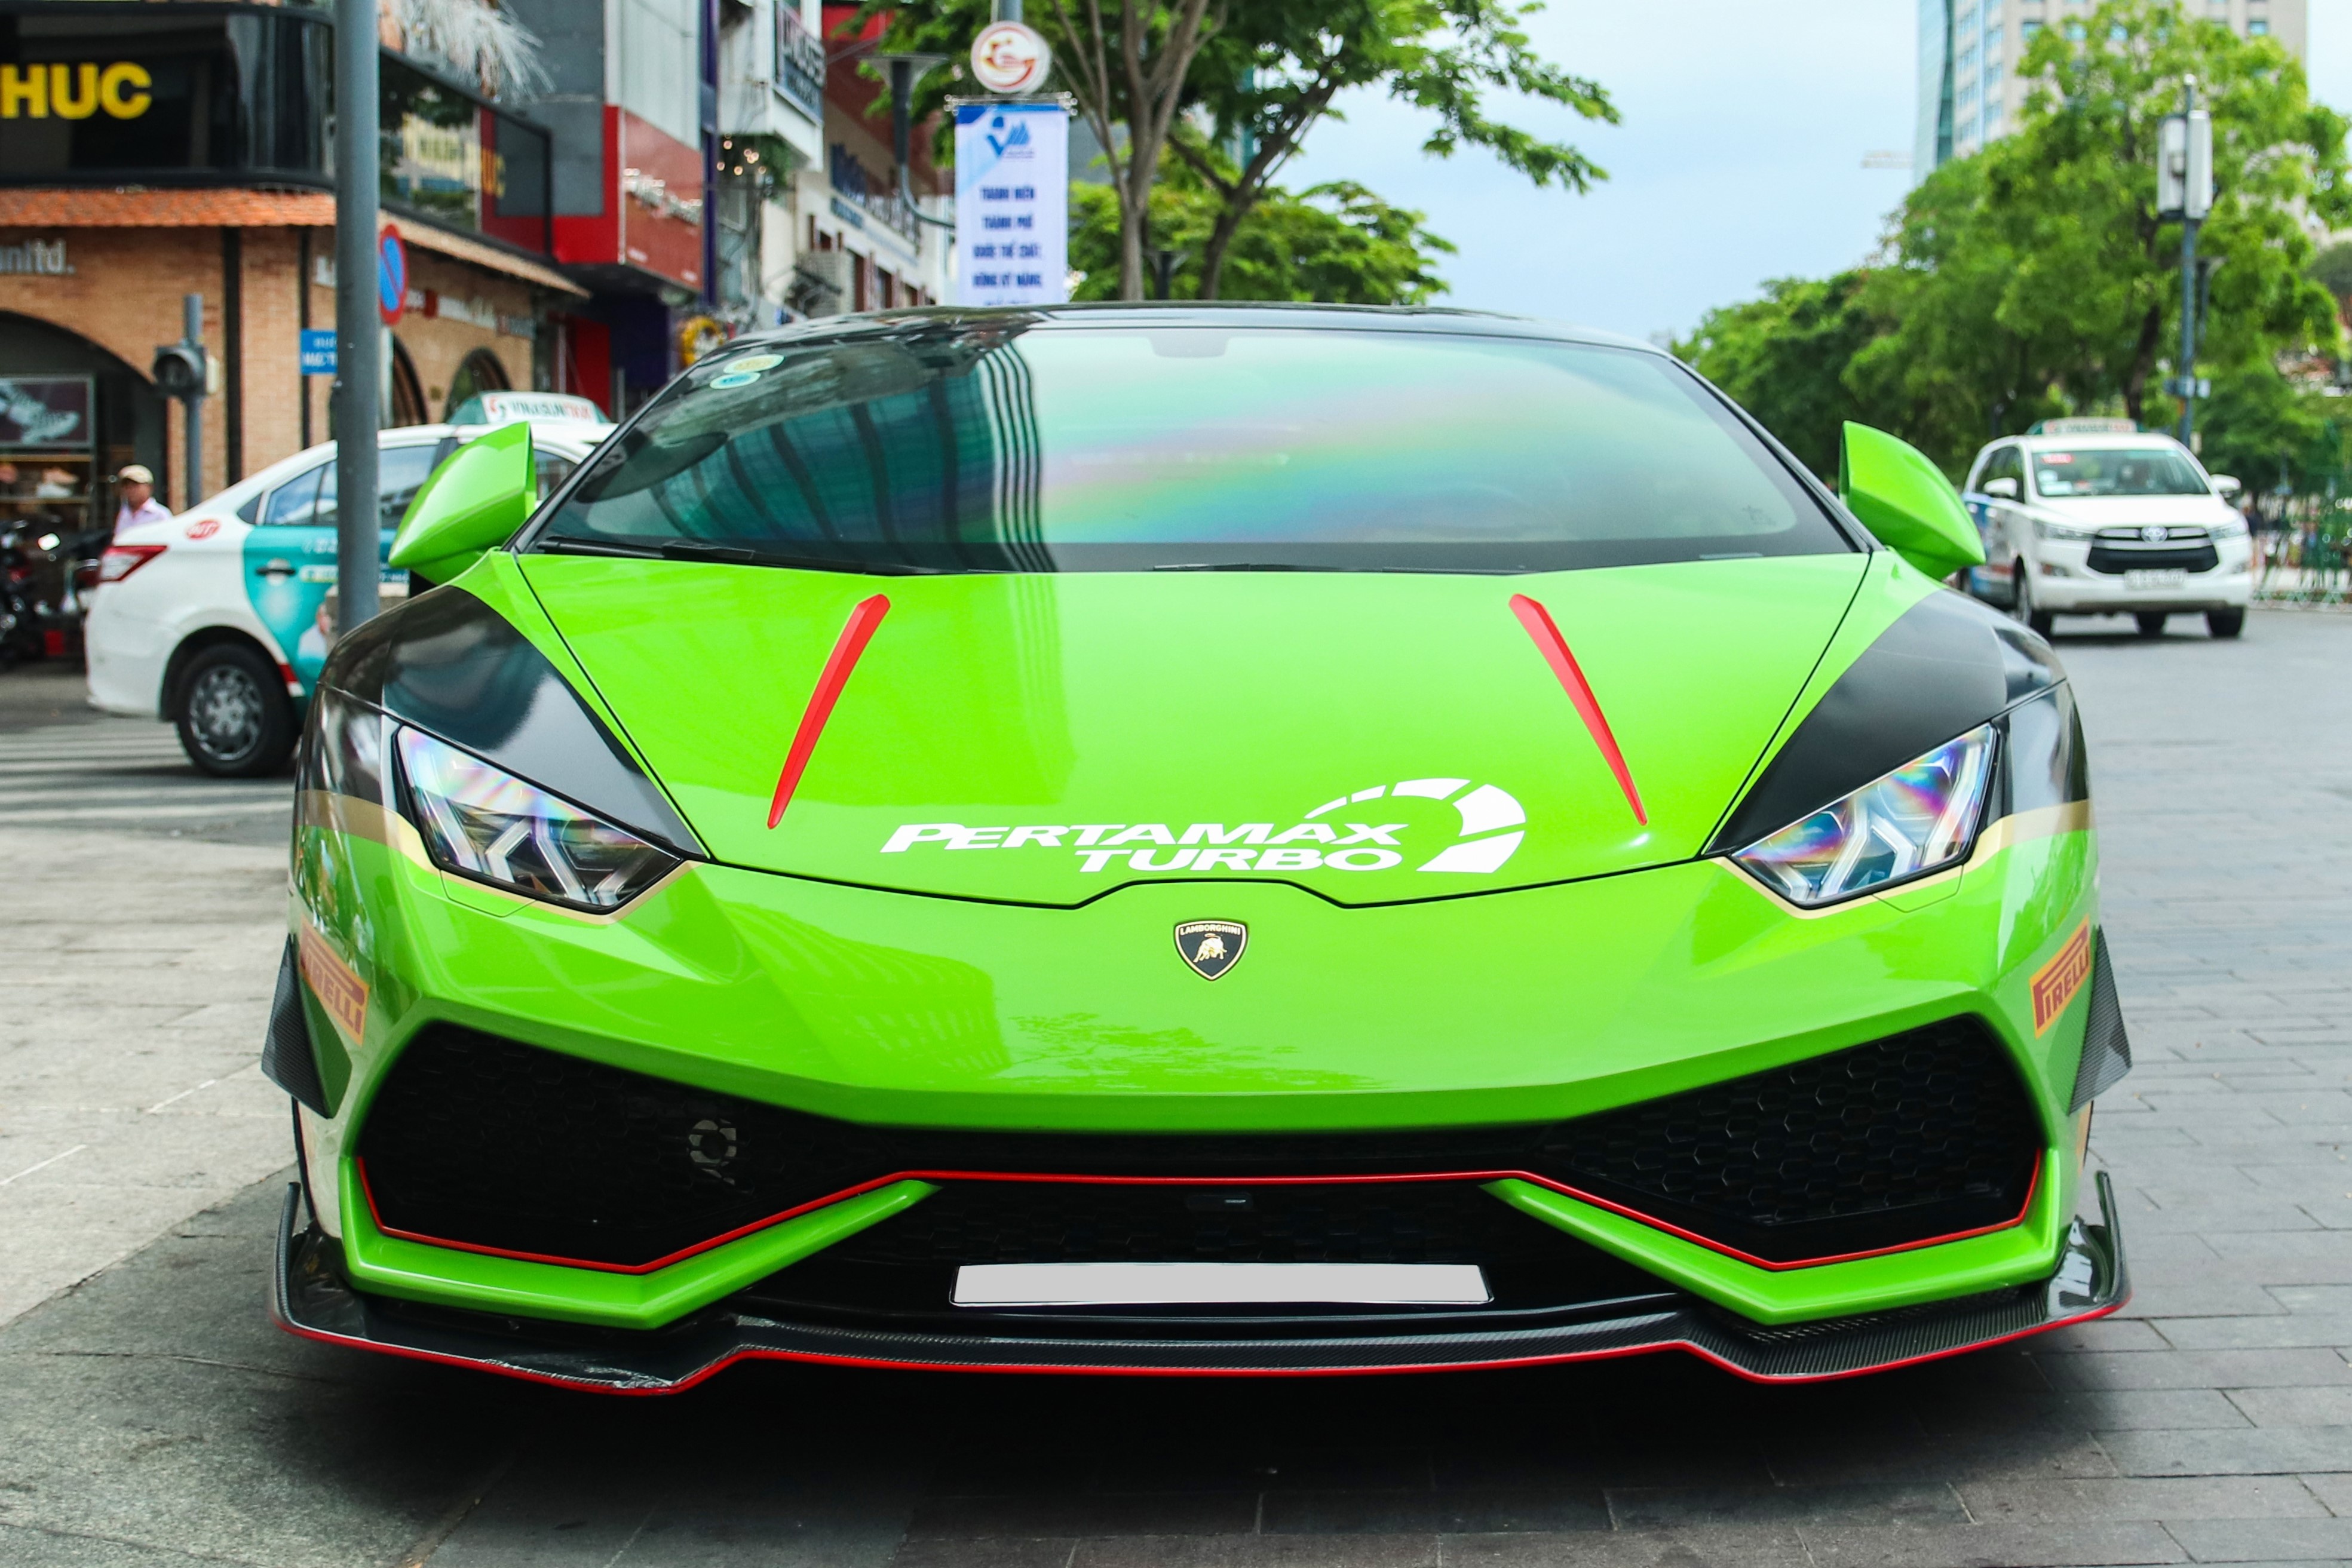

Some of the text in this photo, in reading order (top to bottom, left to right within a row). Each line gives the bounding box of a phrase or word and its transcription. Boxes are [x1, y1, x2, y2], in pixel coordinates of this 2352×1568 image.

[881, 823, 1408, 853] PERTAMAX
[1075, 848, 1403, 872] TURBO
[1179, 923, 1241, 935] LAMBORGHINI
[300, 923, 366, 1036] PIRELLI
[2032, 925, 2089, 1030] PIRELLI
